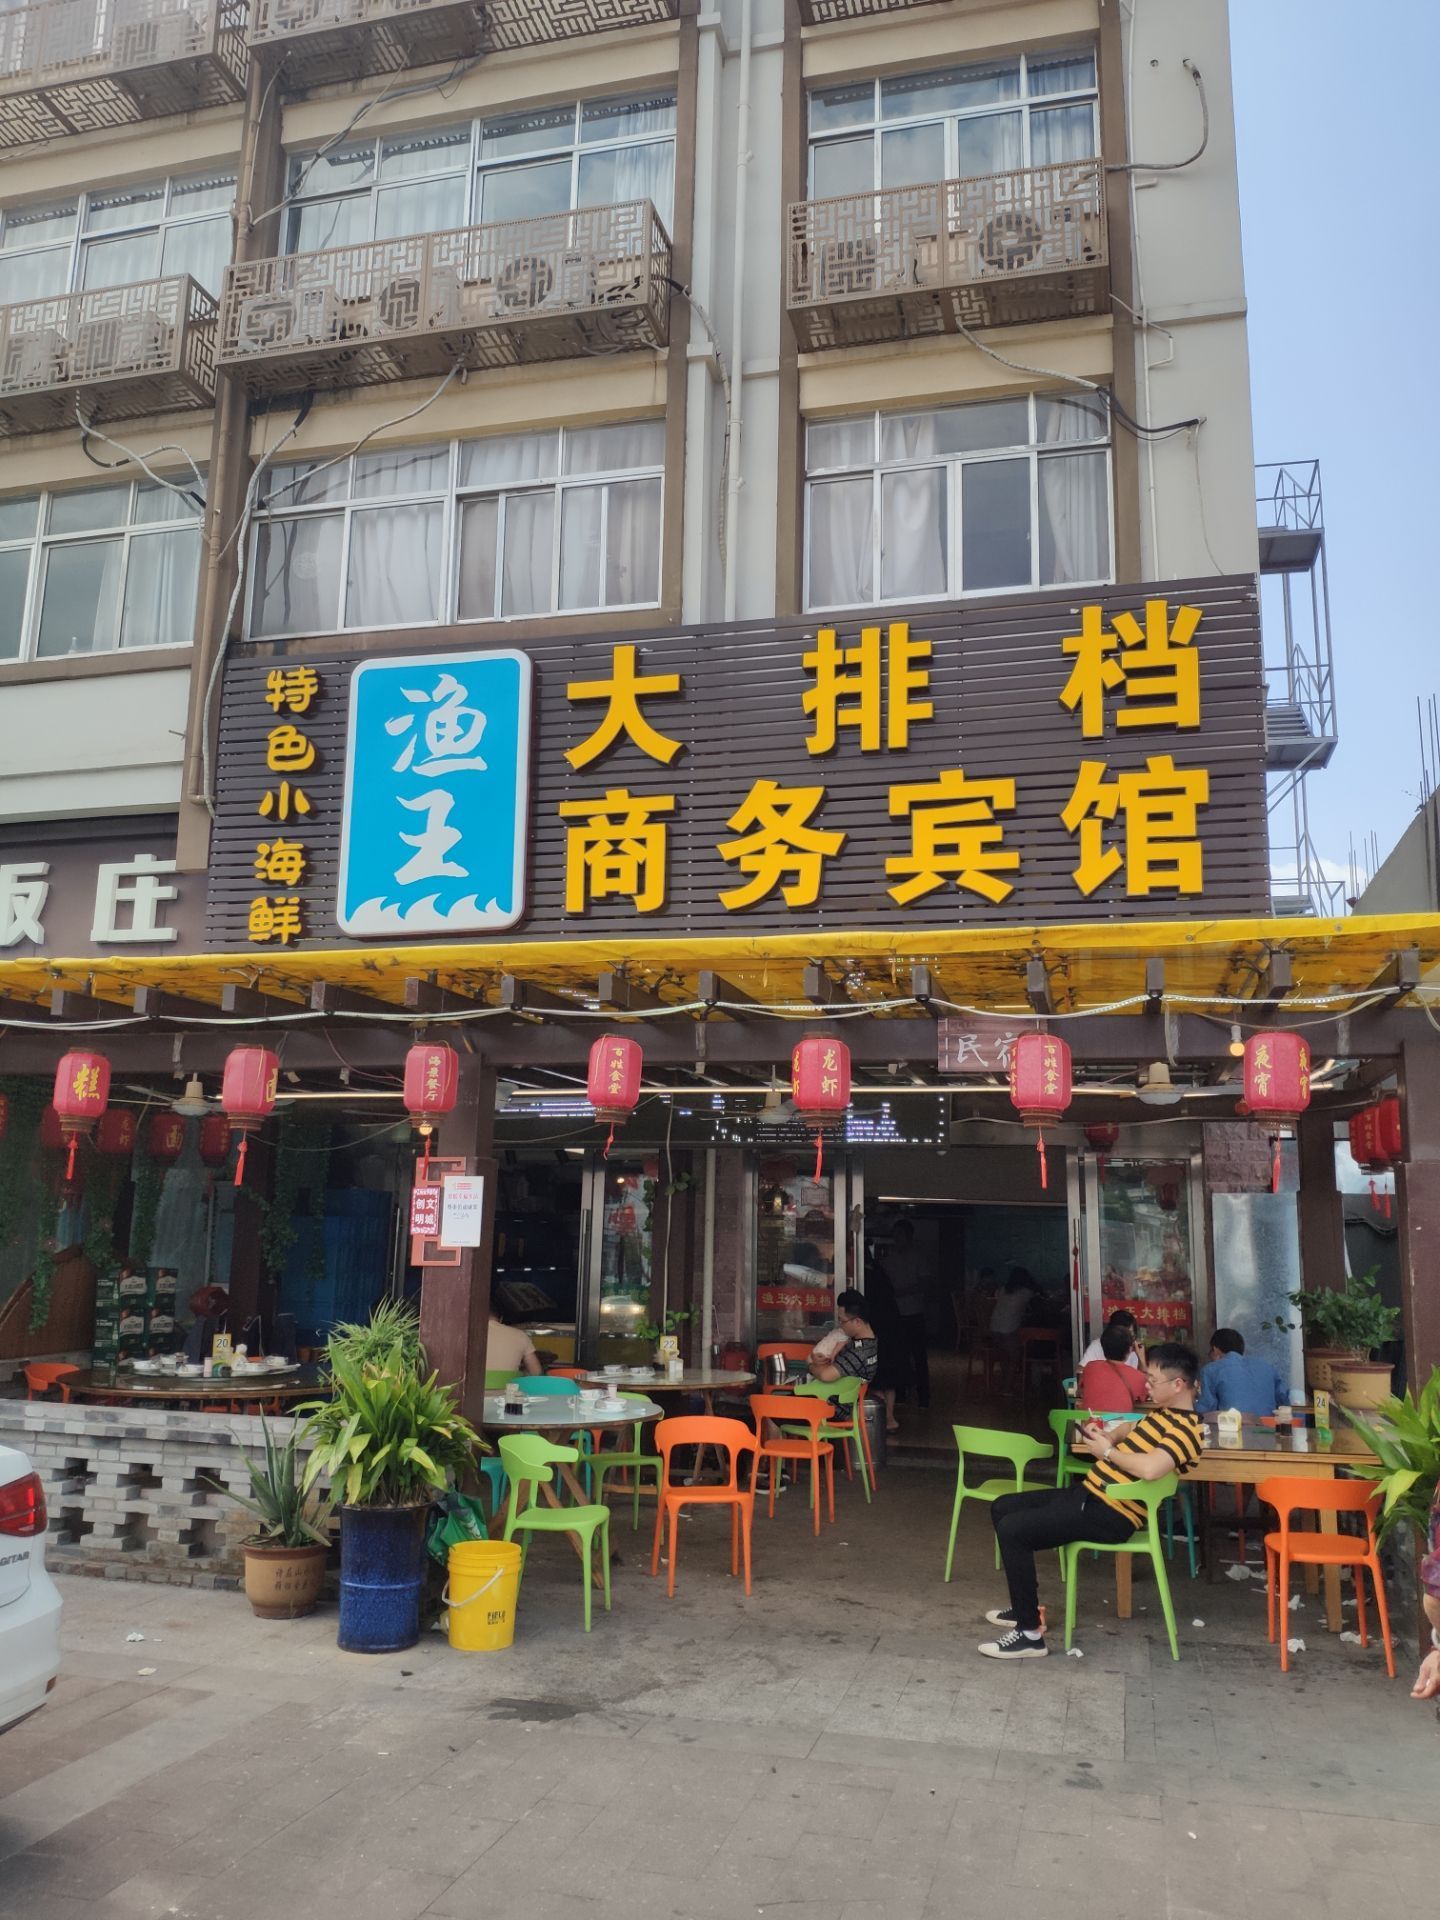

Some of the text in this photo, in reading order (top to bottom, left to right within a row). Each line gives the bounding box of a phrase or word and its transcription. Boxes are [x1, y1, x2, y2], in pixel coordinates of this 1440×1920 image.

[564, 600, 1202, 771] 大排档
[384, 673, 487, 886] 渔王
[247, 666, 319, 946] 特色小海鲜
[558, 755, 1210, 914] 商务宾馆
[609, 1047, 625, 1095] 百姓食堂
[821, 1049, 838, 1097] 龙虾
[1044, 1045, 1060, 1095] 百姓食堂
[1254, 1044, 1273, 1098] 夜宵
[216, 1338, 229, 1349] 20
[664, 1340, 675, 1349] 22
[1316, 1396, 1326, 1409] 24
